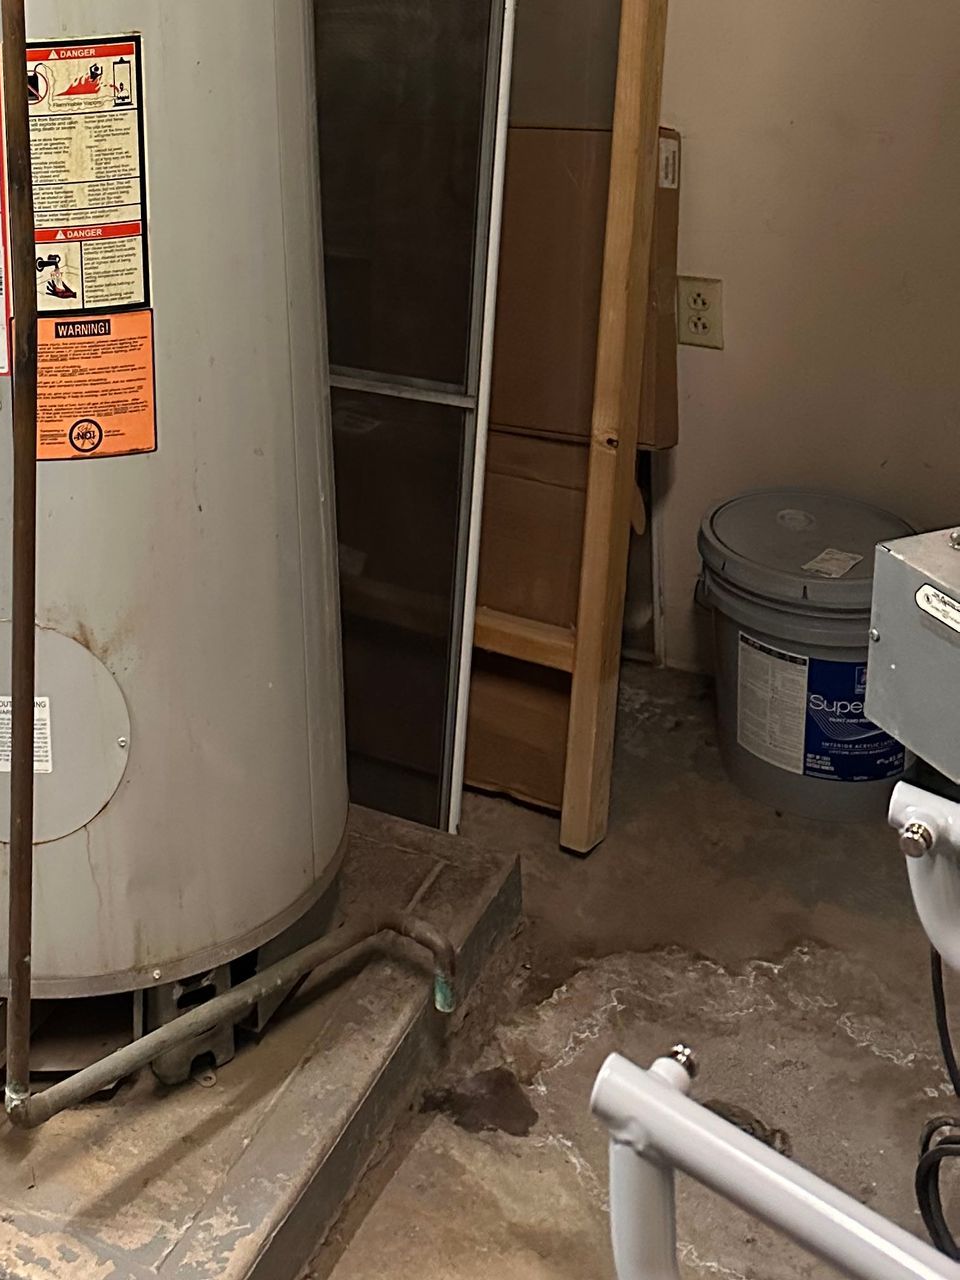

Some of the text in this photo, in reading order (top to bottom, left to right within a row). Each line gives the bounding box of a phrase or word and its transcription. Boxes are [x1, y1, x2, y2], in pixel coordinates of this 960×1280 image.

[60, 48, 96, 58] DANGER
[66, 228, 103, 239] DANGER
[57, 322, 109, 337] WARNING!
[809, 694, 865, 716] Supe
[821, 741, 853, 749] INTERIOR
[854, 741, 879, 749] ACRYLIC
